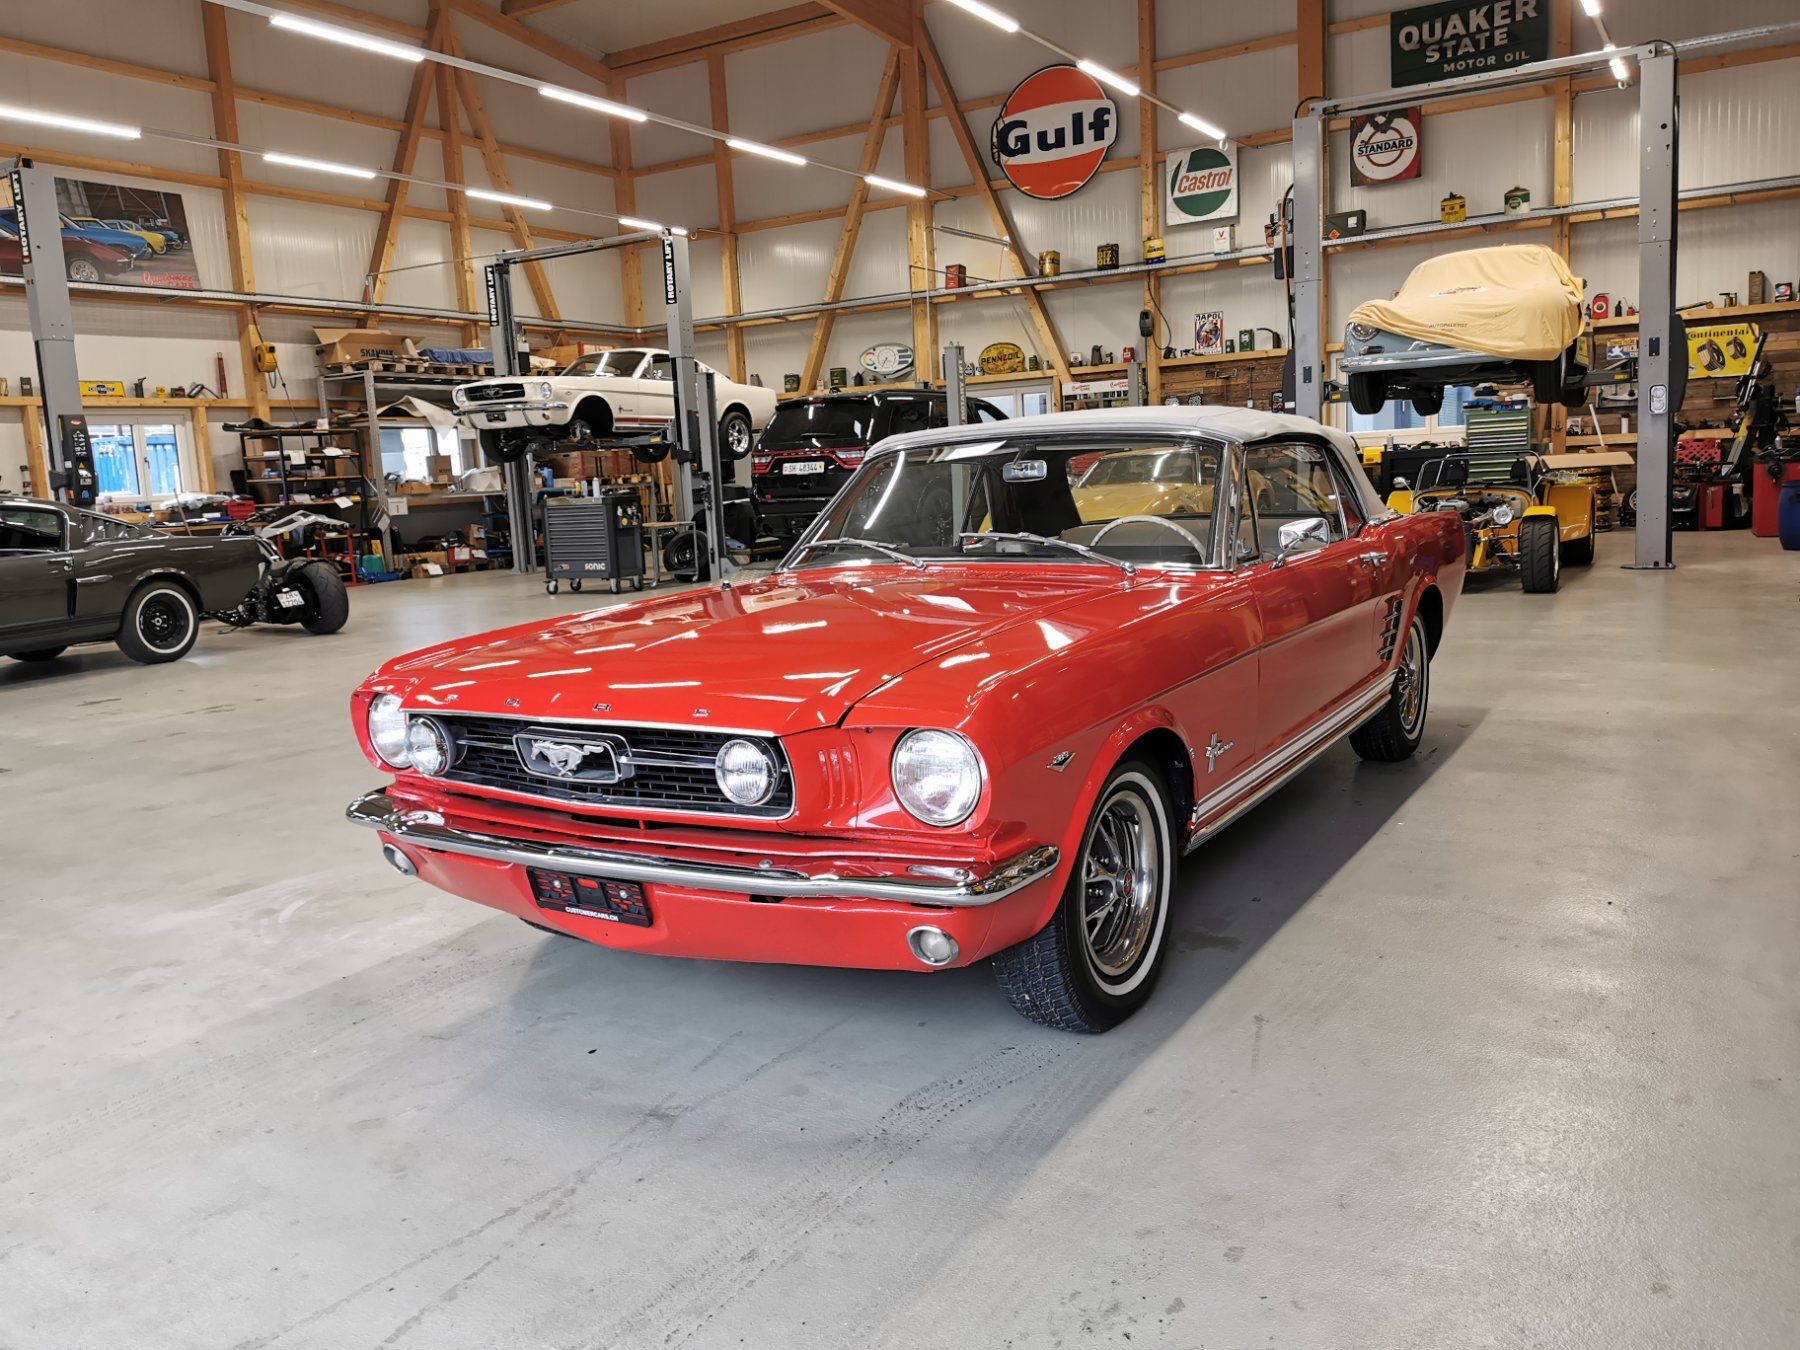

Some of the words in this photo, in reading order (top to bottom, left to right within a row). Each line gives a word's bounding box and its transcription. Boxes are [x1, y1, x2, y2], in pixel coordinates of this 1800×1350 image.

[1398, 0, 1538, 51] QUAKER
[1425, 27, 1508, 63] STATE
[1443, 55, 1497, 73] MOTOR
[1504, 50, 1530, 63] OIL
[997, 106, 1111, 158] Gulf
[1357, 138, 1414, 155] STANDARD
[12, 172, 22, 201] LIFT
[1177, 168, 1233, 194] Castrol
[16, 203, 30, 256] ROTARY
[664, 239, 672, 260] LIFT
[486, 267, 494, 285] LIFT
[665, 261, 675, 299] ROTARY
[488, 286, 498, 321] ROTARY
[980, 351, 1021, 364] PENNZOIL
